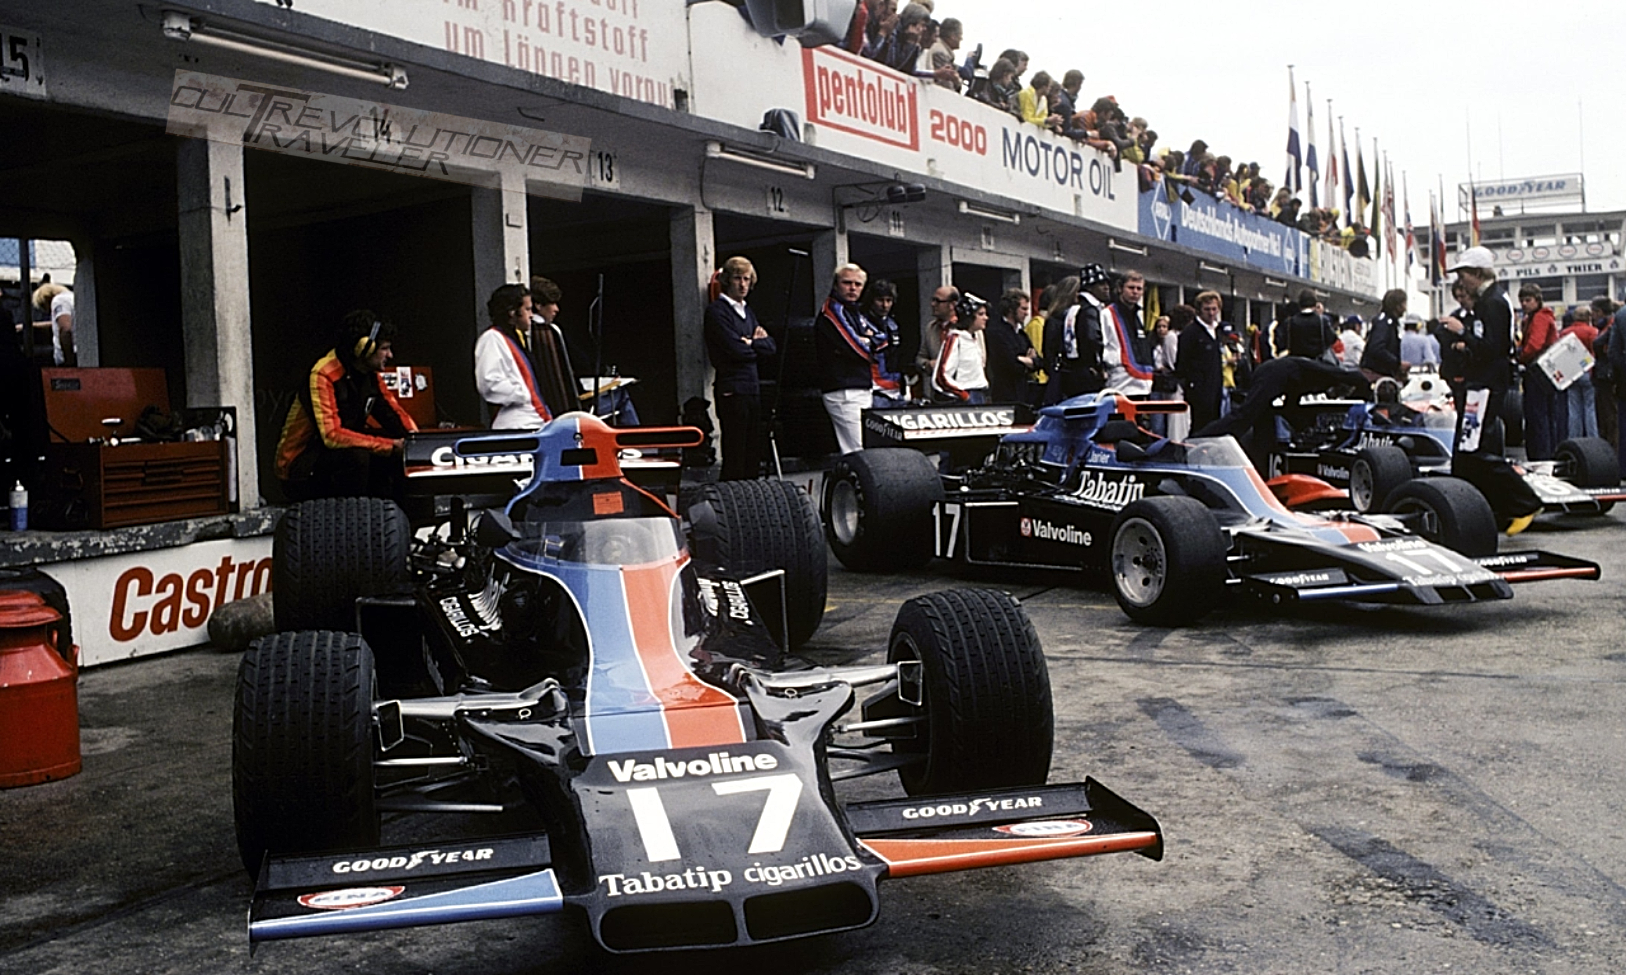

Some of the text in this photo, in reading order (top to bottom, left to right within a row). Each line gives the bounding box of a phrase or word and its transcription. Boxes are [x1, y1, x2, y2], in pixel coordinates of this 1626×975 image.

[445, 21, 484, 60] um
[817, 65, 907, 134] pentolub
[598, 152, 613, 182] 13
[930, 109, 1115, 200] 2000 MOTOR OIL
[770, 186, 784, 212] 12
[1515, 265, 1541, 277] PILS
[883, 411, 1015, 430] IGARILLOS
[932, 502, 960, 558] 17
[1032, 519, 1092, 546] Valvoline
[1385, 549, 1463, 575] 17
[607, 752, 779, 782] Valvoline
[626, 773, 804, 862] 17
[598, 852, 863, 897] Tabatip cigarillos
